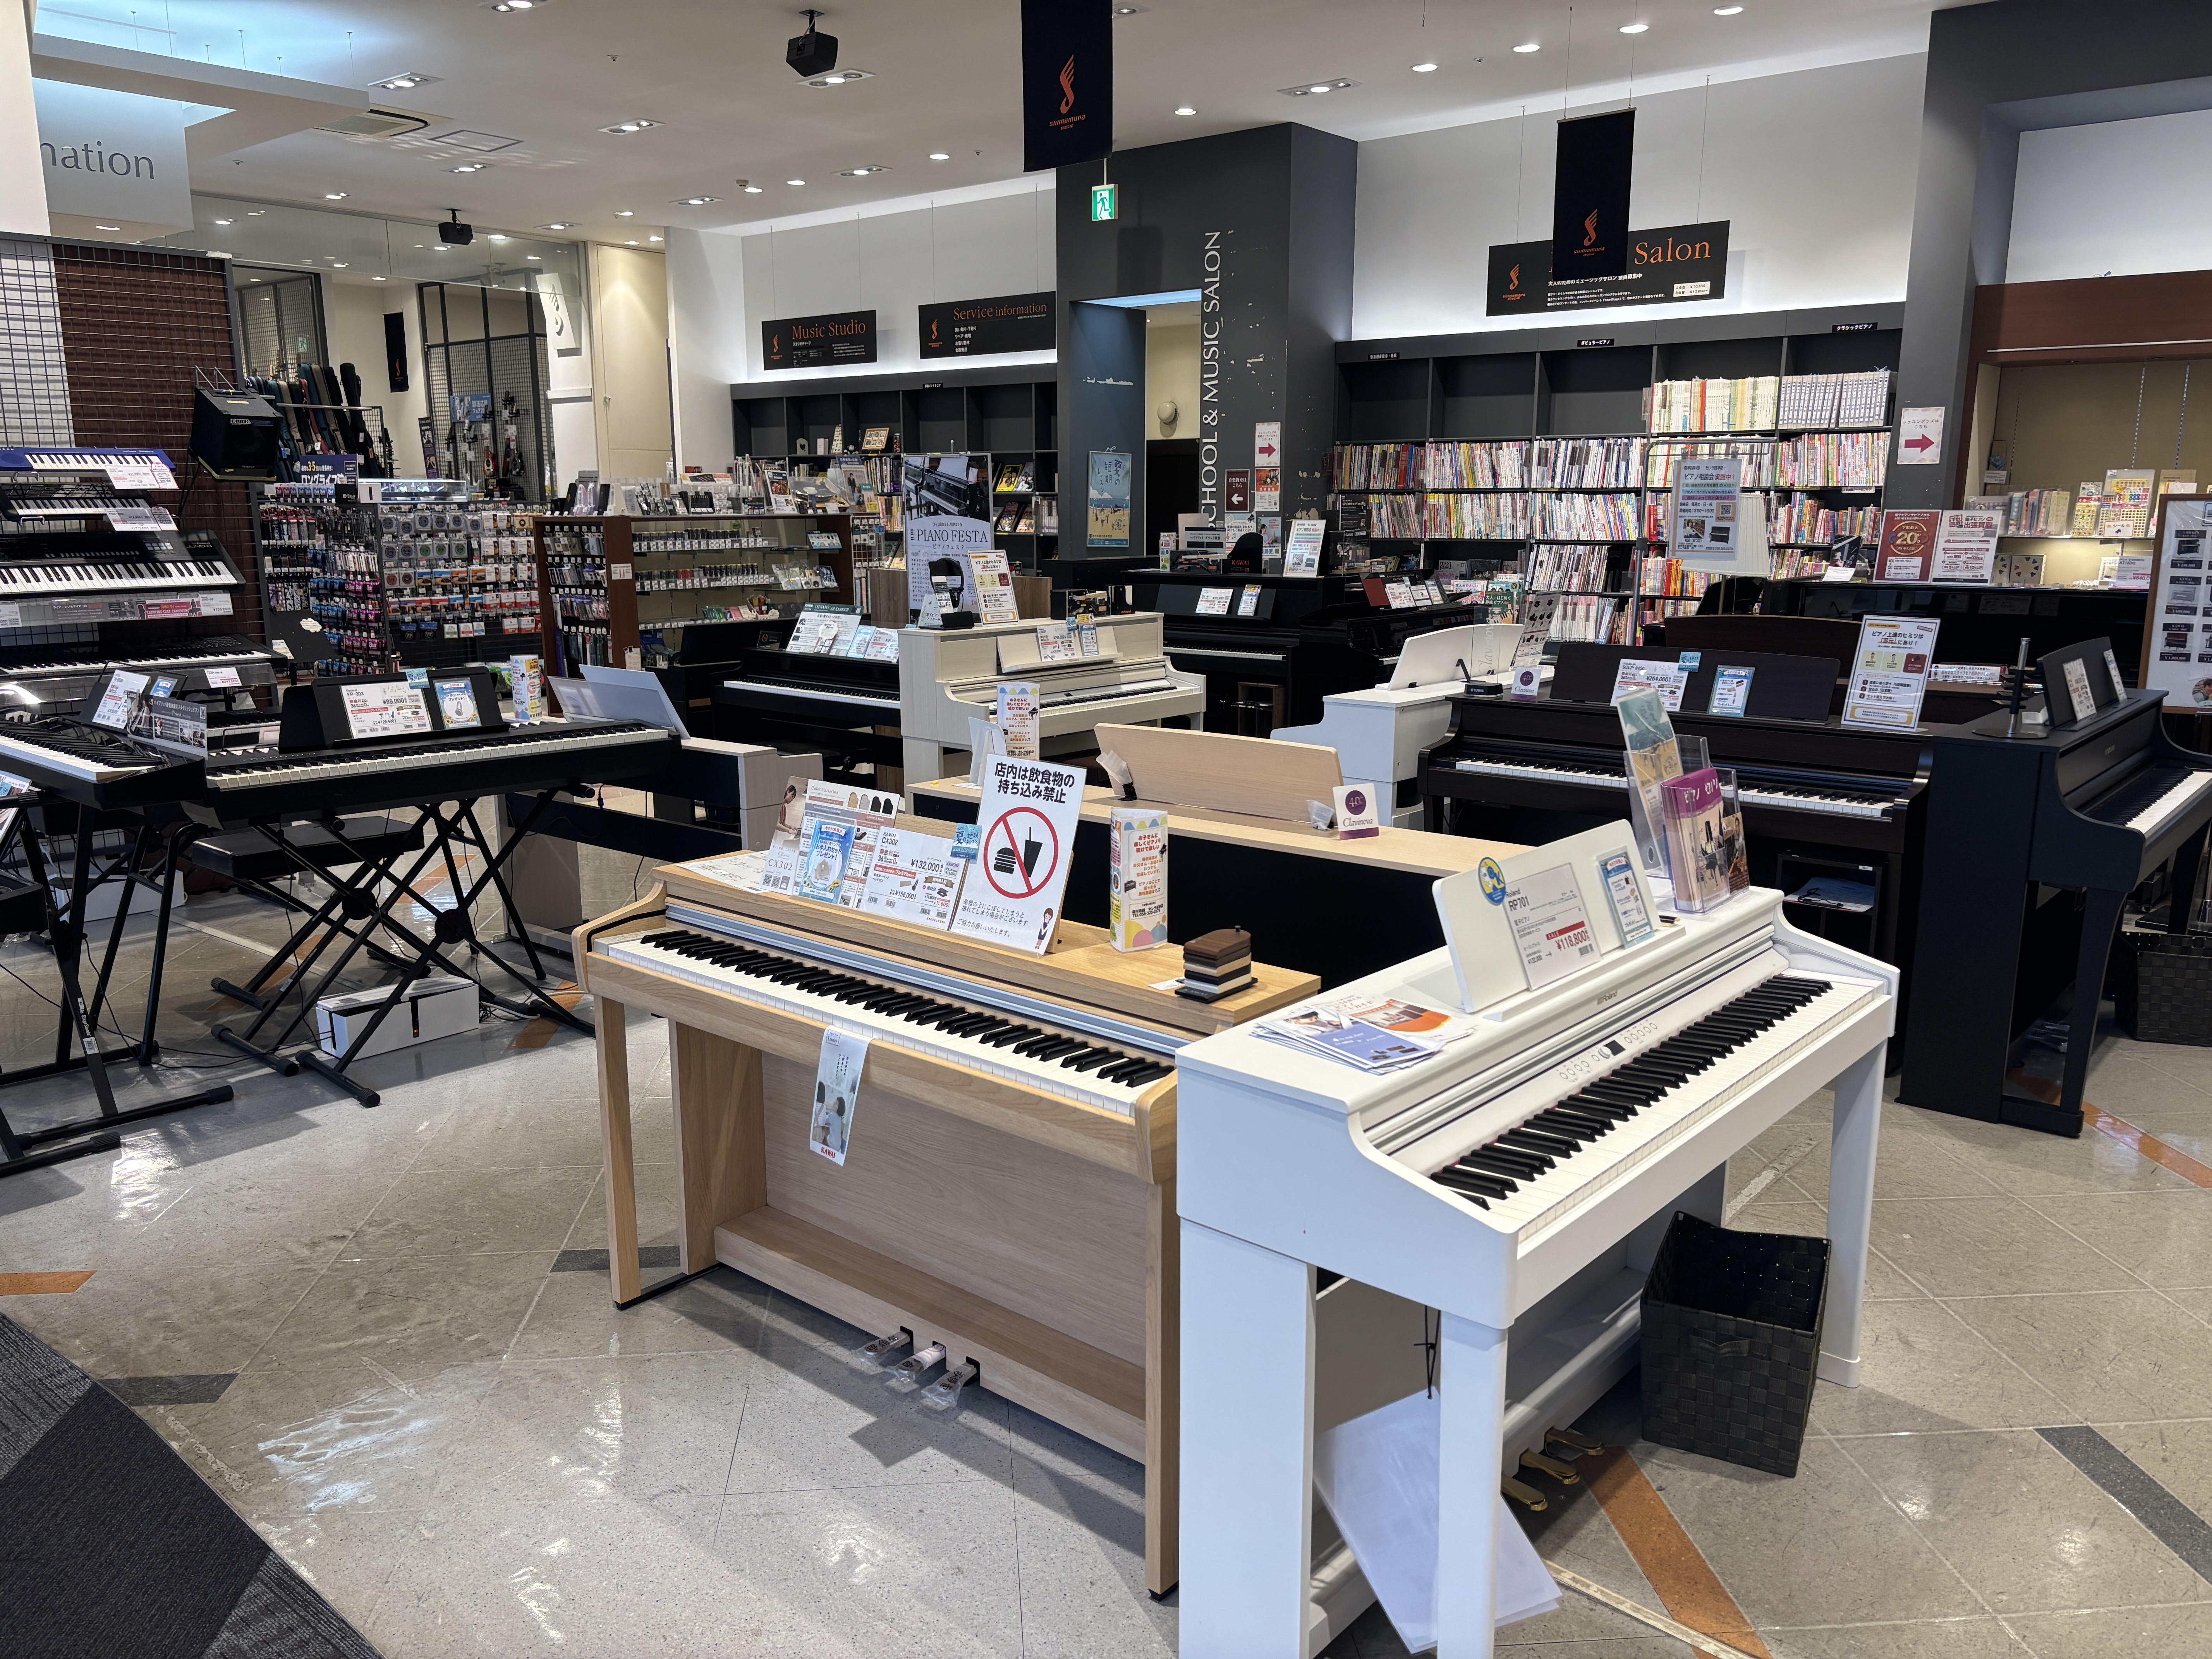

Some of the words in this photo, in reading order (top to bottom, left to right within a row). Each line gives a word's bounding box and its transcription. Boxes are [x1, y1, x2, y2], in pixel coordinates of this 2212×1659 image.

[1635, 237, 1711, 264] Salon
[1204, 231, 1221, 312] SALON
[953, 306, 994, 321] Service
[996, 303, 1047, 316] information
[792, 323, 825, 340] Music
[829, 319, 866, 337] Studio
[1202, 321, 1220, 402] MUSIC
[1202, 409, 1218, 426] &
[1104, 461, 1112, 484] 短期
[1114, 459, 1123, 486] 夏の
[917, 529, 949, 542] PIANO
[951, 530, 988, 543] FESTA
[1895, 532, 1915, 545] 20
[1872, 630, 1924, 639] ピアノ上達のヒミツは
[1880, 638, 1917, 646] 「足元」にあり！
[994, 762, 1075, 788] 店内は飲食物の
[998, 778, 1066, 804] 持ち込み禁止
[815, 844, 842, 854] お手入れセット
[881, 837, 898, 846] CX302
[1133, 838, 1161, 847] 楽しくピアノを
[1136, 845, 1159, 853] 続けて欲しい
[768, 858, 793, 871] CX302
[910, 859, 940, 872] ¥132,000
[1138, 878, 1160, 886] ピアノのことで
[895, 890, 914, 900] ¥156,000
[1508, 895, 1530, 912] RP701
[961, 904, 1029, 926] 壊れてしまう場合がございます
[964, 898, 1025, 918] 楽器の上にこぼしてしまうと
[957, 918, 1010, 937] ご協力お願いいたします。
[1555, 930, 1587, 951] ¥118,800
[821, 1147, 836, 1159] KAWAI
